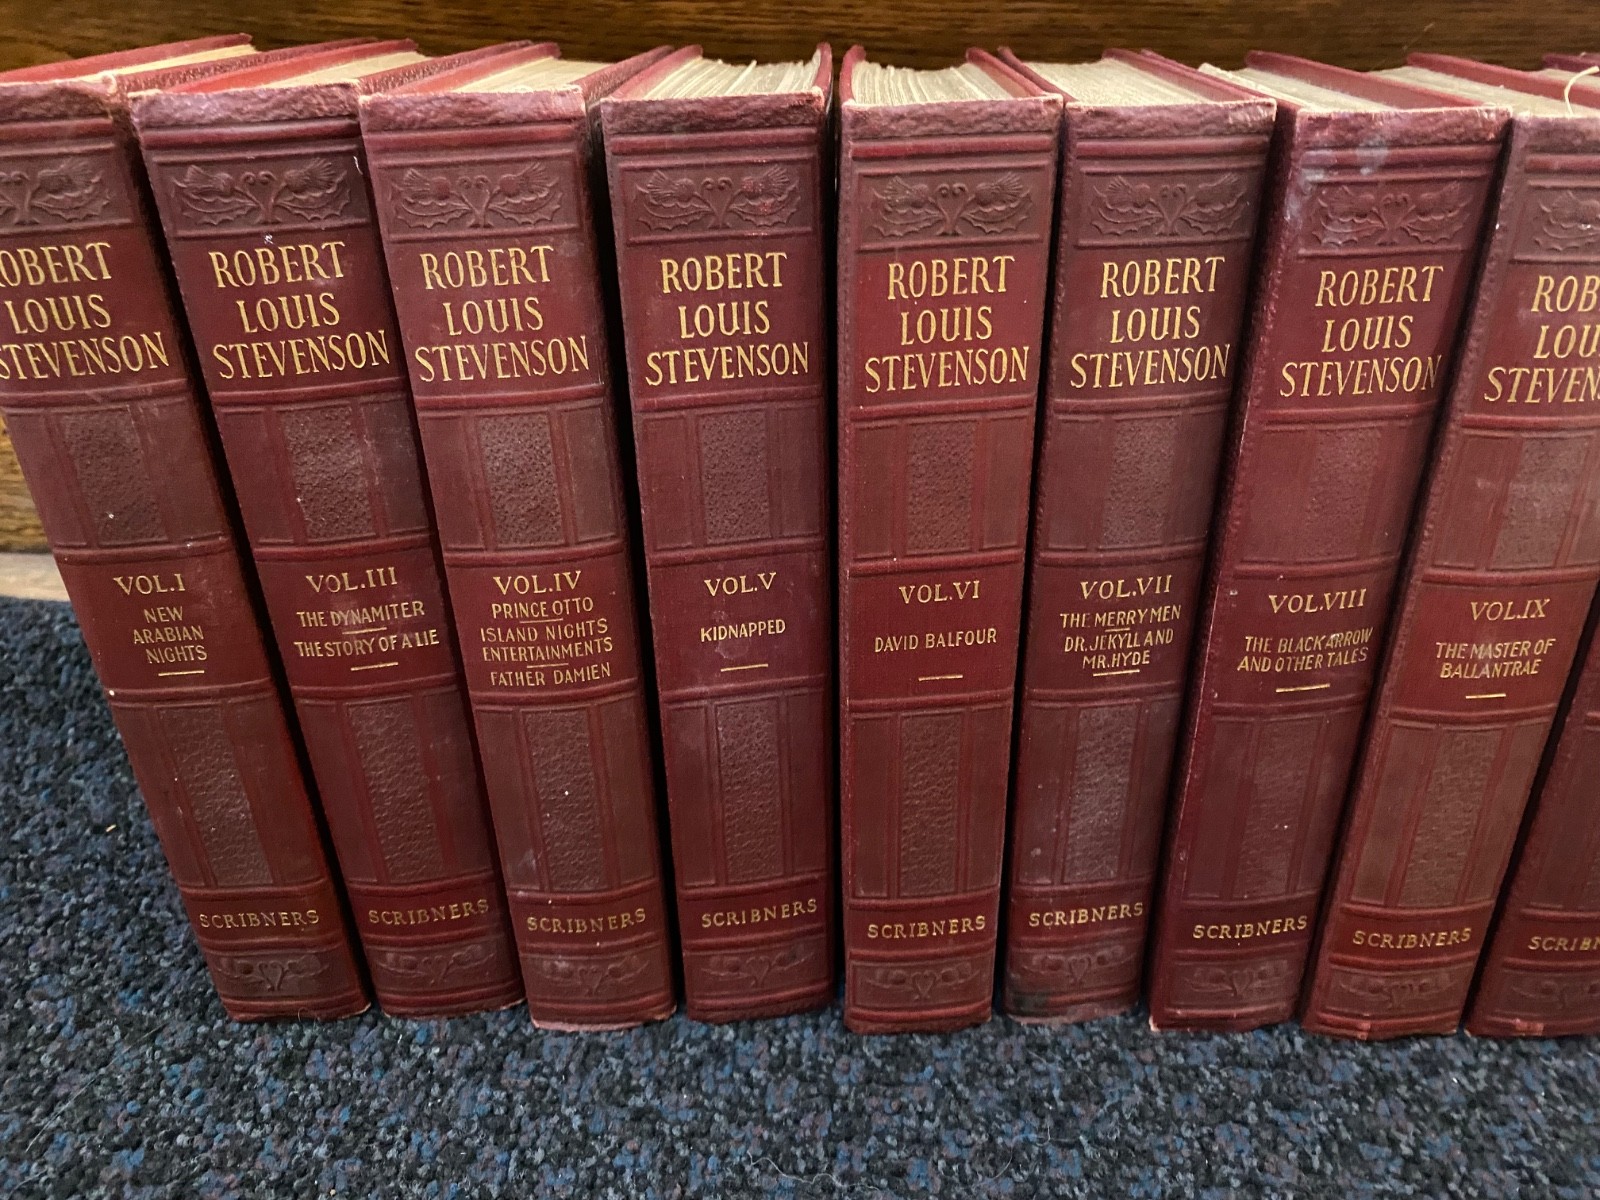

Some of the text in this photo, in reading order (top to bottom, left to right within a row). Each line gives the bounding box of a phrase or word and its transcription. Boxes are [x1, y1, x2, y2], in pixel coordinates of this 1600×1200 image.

[0, 242, 111, 287] OBERT
[208, 241, 346, 288] ROBERT
[420, 245, 554, 290] ROBERT
[660, 251, 788, 293] ROBERT
[887, 255, 1015, 300] ROBERT
[1100, 256, 1225, 298] ROBERT
[1315, 265, 1444, 307] ROBERT
[1530, 274, 1600, 313] ROB
[6, 294, 112, 334] LOUIS
[236, 293, 341, 333] LOUIS
[443, 297, 544, 336] LOUIS
[678, 300, 771, 339] LOUIS
[900, 306, 993, 346] LOUIS
[1110, 305, 1201, 344] LOUIS
[1321, 315, 1413, 353] LOUIS
[1533, 324, 1600, 359] LOU
[212, 329, 391, 379] STEVENSON
[414, 335, 591, 382] STEVENSON
[645, 341, 809, 386] STEVENSON
[1070, 343, 1231, 389] STEVENSON
[864, 346, 1030, 393] STEVENSON
[1279, 354, 1442, 397] STEVENSON
[1484, 365, 1600, 404] STEVEN
[143, 605, 183, 624] NEW
[296, 600, 425, 627] THE DYNAMITER
[491, 596, 594, 619] PRINCE OTTO
[1060, 604, 1182, 628] THE MERRY MEN
[133, 624, 204, 645] ARABIAN
[293, 628, 440, 657] THE STORY OF A LIE
[480, 617, 609, 643] ISLAND NIGHTS
[700, 619, 786, 642] KIDNAPPED
[874, 627, 997, 653] DAVID BALFOUR
[1143, 628, 1174, 647] AND
[1244, 626, 1374, 654] THE BLACK ARROW
[145, 644, 208, 664] NIGHTS
[482, 636, 614, 662] ENTERTAINMENTS
[1236, 646, 1369, 673] AND OTHER TALES
[1435, 638, 1556, 660] THE MASTER OF
[490, 661, 611, 687] FATHER DAMIEN
[1440, 659, 1542, 679] BALLANTRAE
[199, 909, 321, 929] SCRIBNERS
[368, 898, 490, 926] SCRIBNERS
[526, 907, 647, 935] SCRIBNERS
[701, 898, 818, 928] SCRIBNERS
[1028, 901, 1145, 928] SCRIBNERS
[867, 914, 986, 940] SCRIBNERS
[1192, 915, 1308, 940] SCRIBNERS
[1352, 927, 1472, 950] SCRIBNERS
